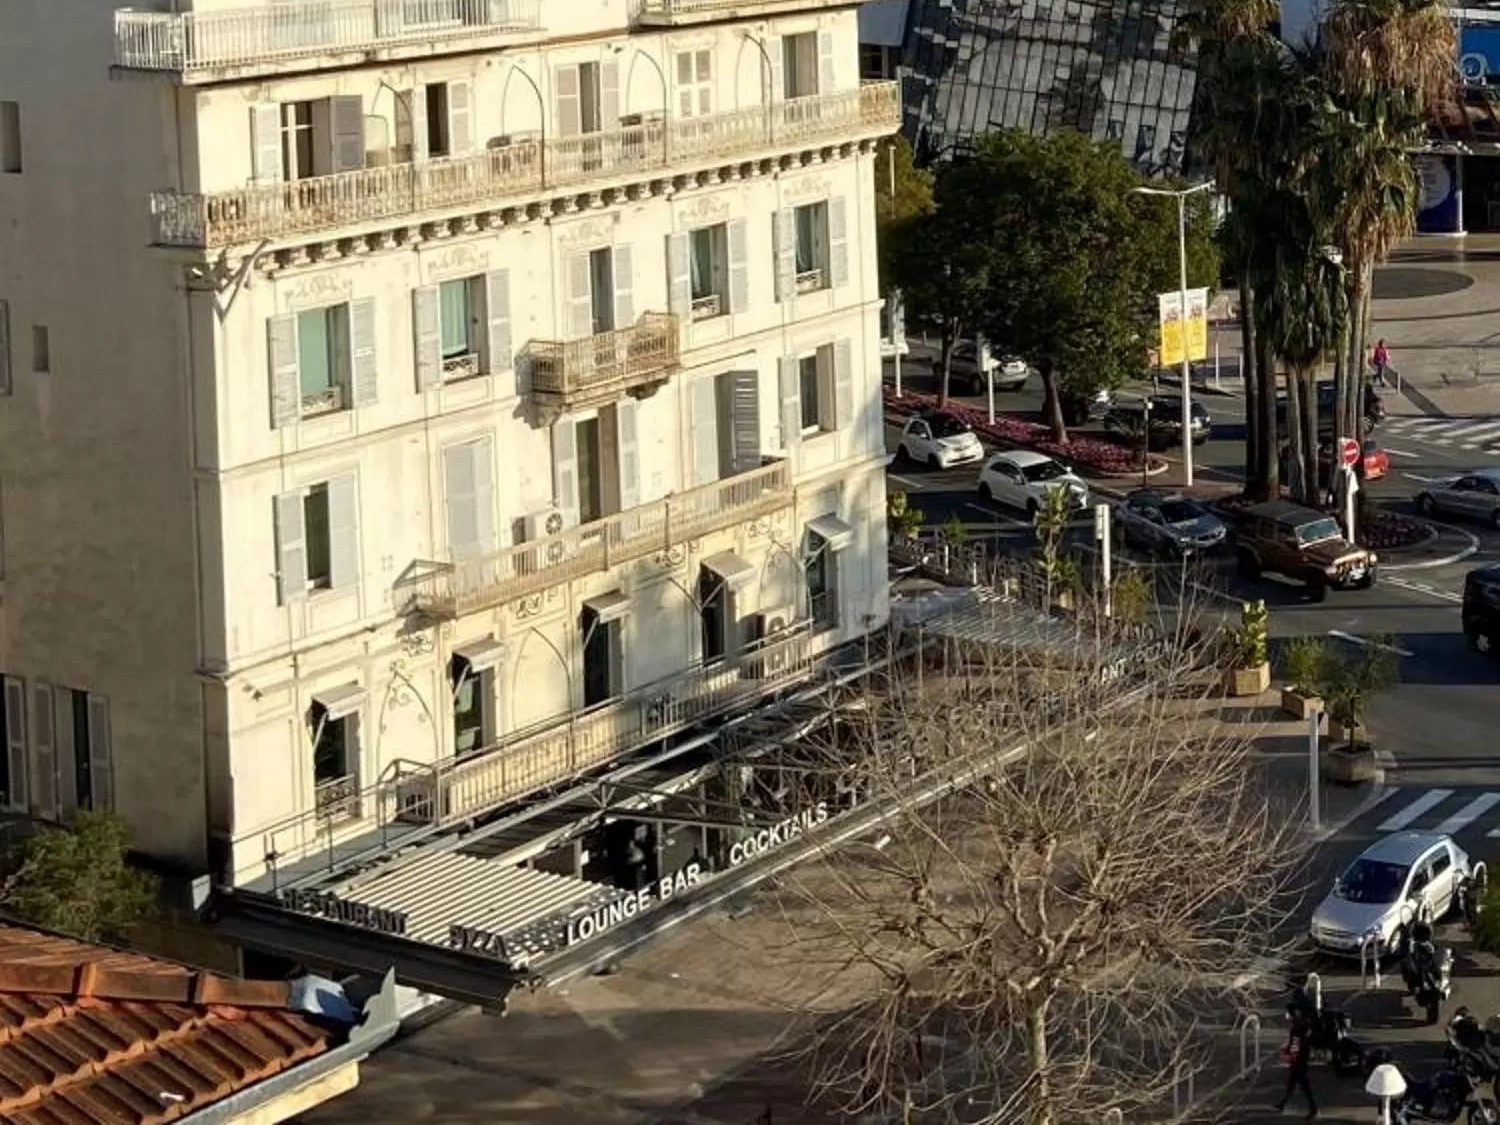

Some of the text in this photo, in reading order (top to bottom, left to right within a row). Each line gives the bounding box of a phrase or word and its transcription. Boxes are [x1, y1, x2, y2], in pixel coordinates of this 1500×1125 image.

[283, 887, 507, 959] RESTAURANT PIZZA
[567, 801, 828, 946] LOUNGE BAR COCKTAILS
